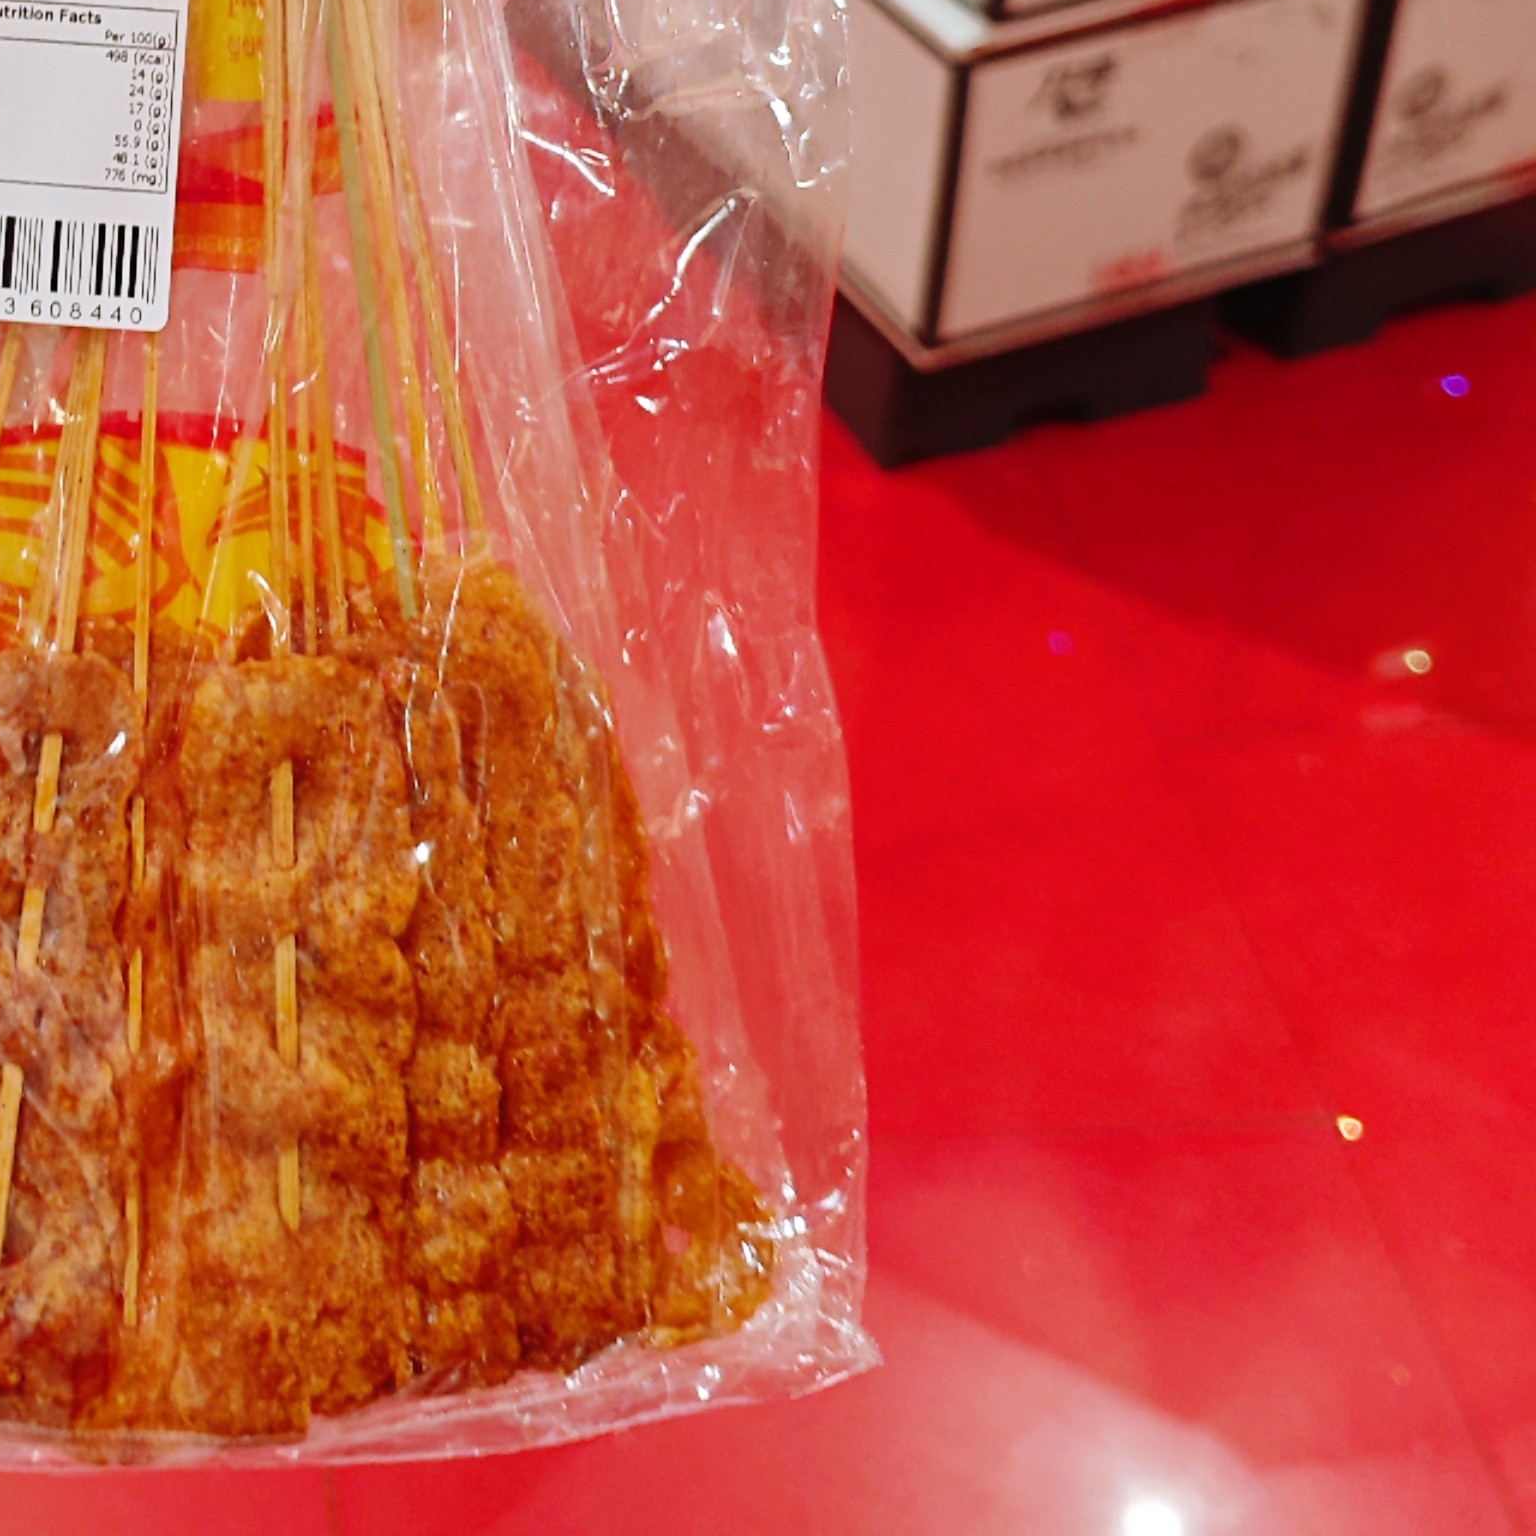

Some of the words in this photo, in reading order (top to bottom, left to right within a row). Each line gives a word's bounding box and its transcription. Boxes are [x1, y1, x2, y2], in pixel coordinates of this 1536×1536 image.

[59, 8, 102, 25] Facts
[104, 29, 125, 42] Per
[105, 50, 129, 63] 498
[131, 68, 146, 81] 14
[129, 84, 145, 97] 24
[129, 102, 144, 115] 17
[134, 120, 142, 132] 0
[104, 167, 126, 182] 776
[30, 299, 143, 325] 608440
